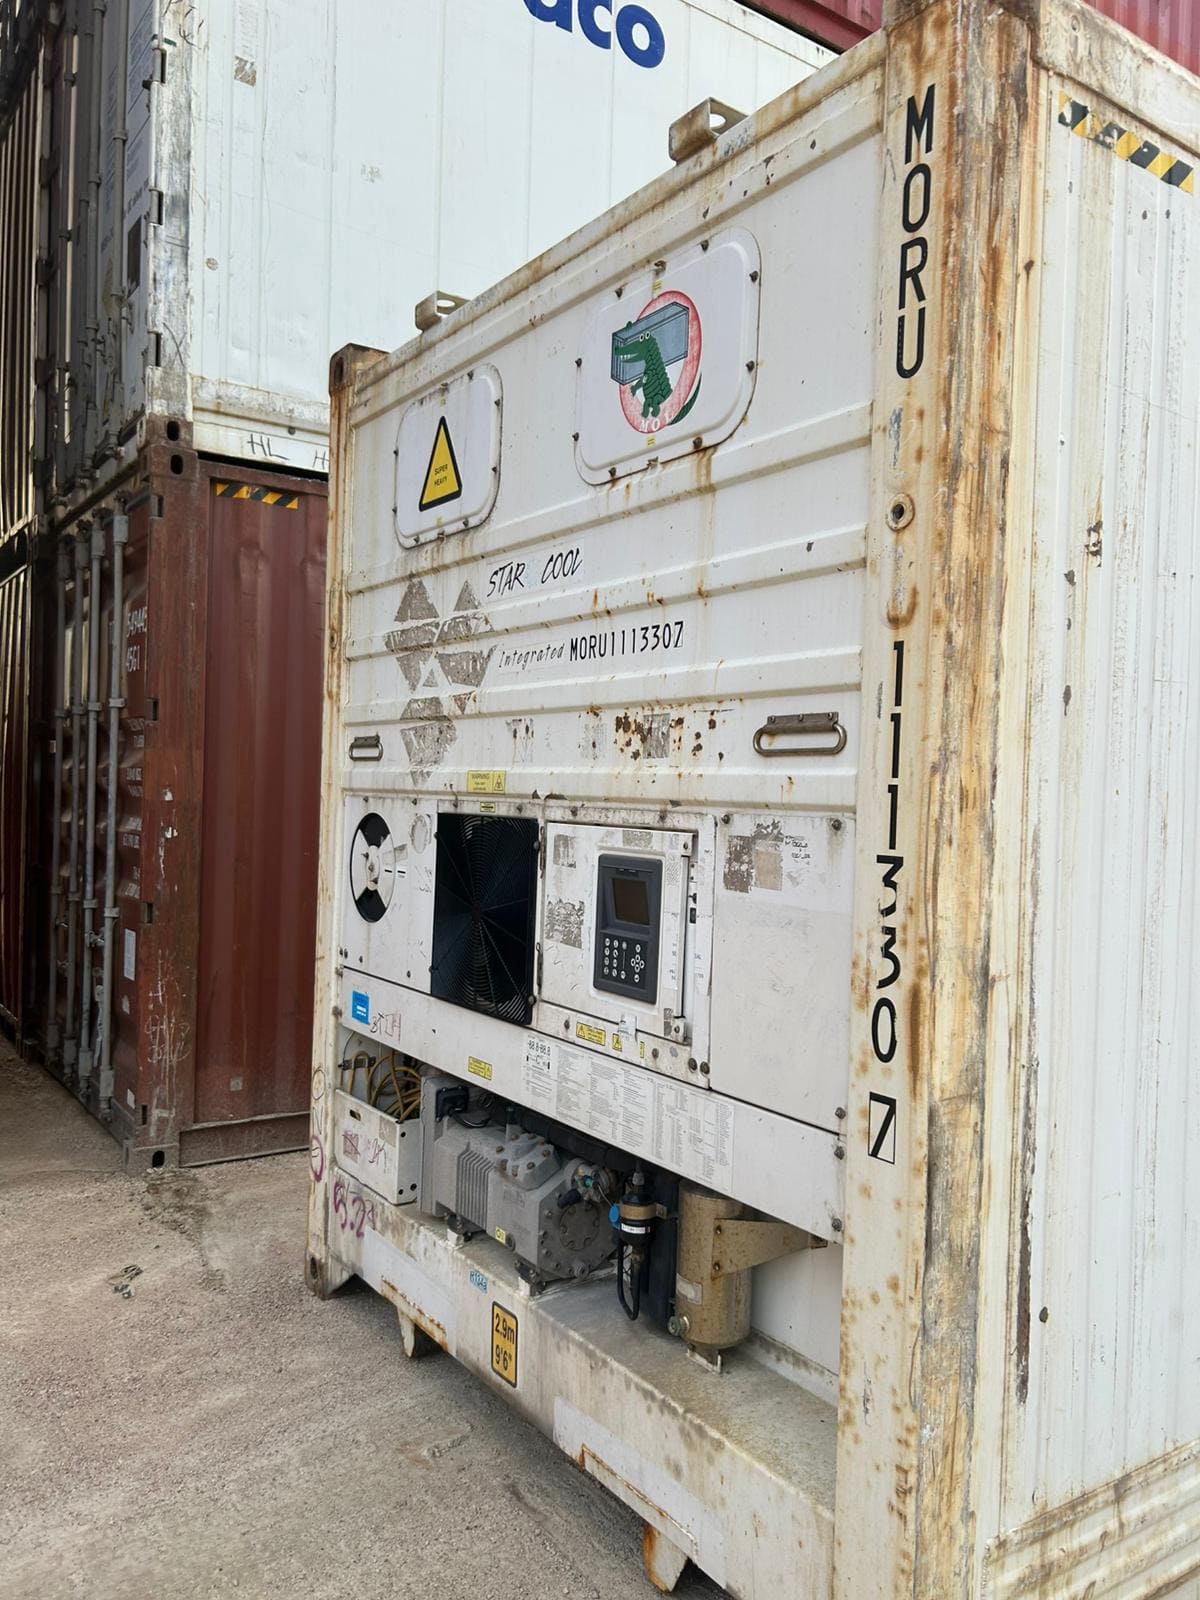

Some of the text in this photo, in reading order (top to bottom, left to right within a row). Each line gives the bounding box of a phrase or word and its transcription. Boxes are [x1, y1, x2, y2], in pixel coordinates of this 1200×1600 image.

[896, 83, 935, 379] MORU
[487, 547, 583, 597] STAR COOL
[499, 620, 684, 670] Integrated MORU1113307
[495, 1313, 515, 1344] 2.9m
